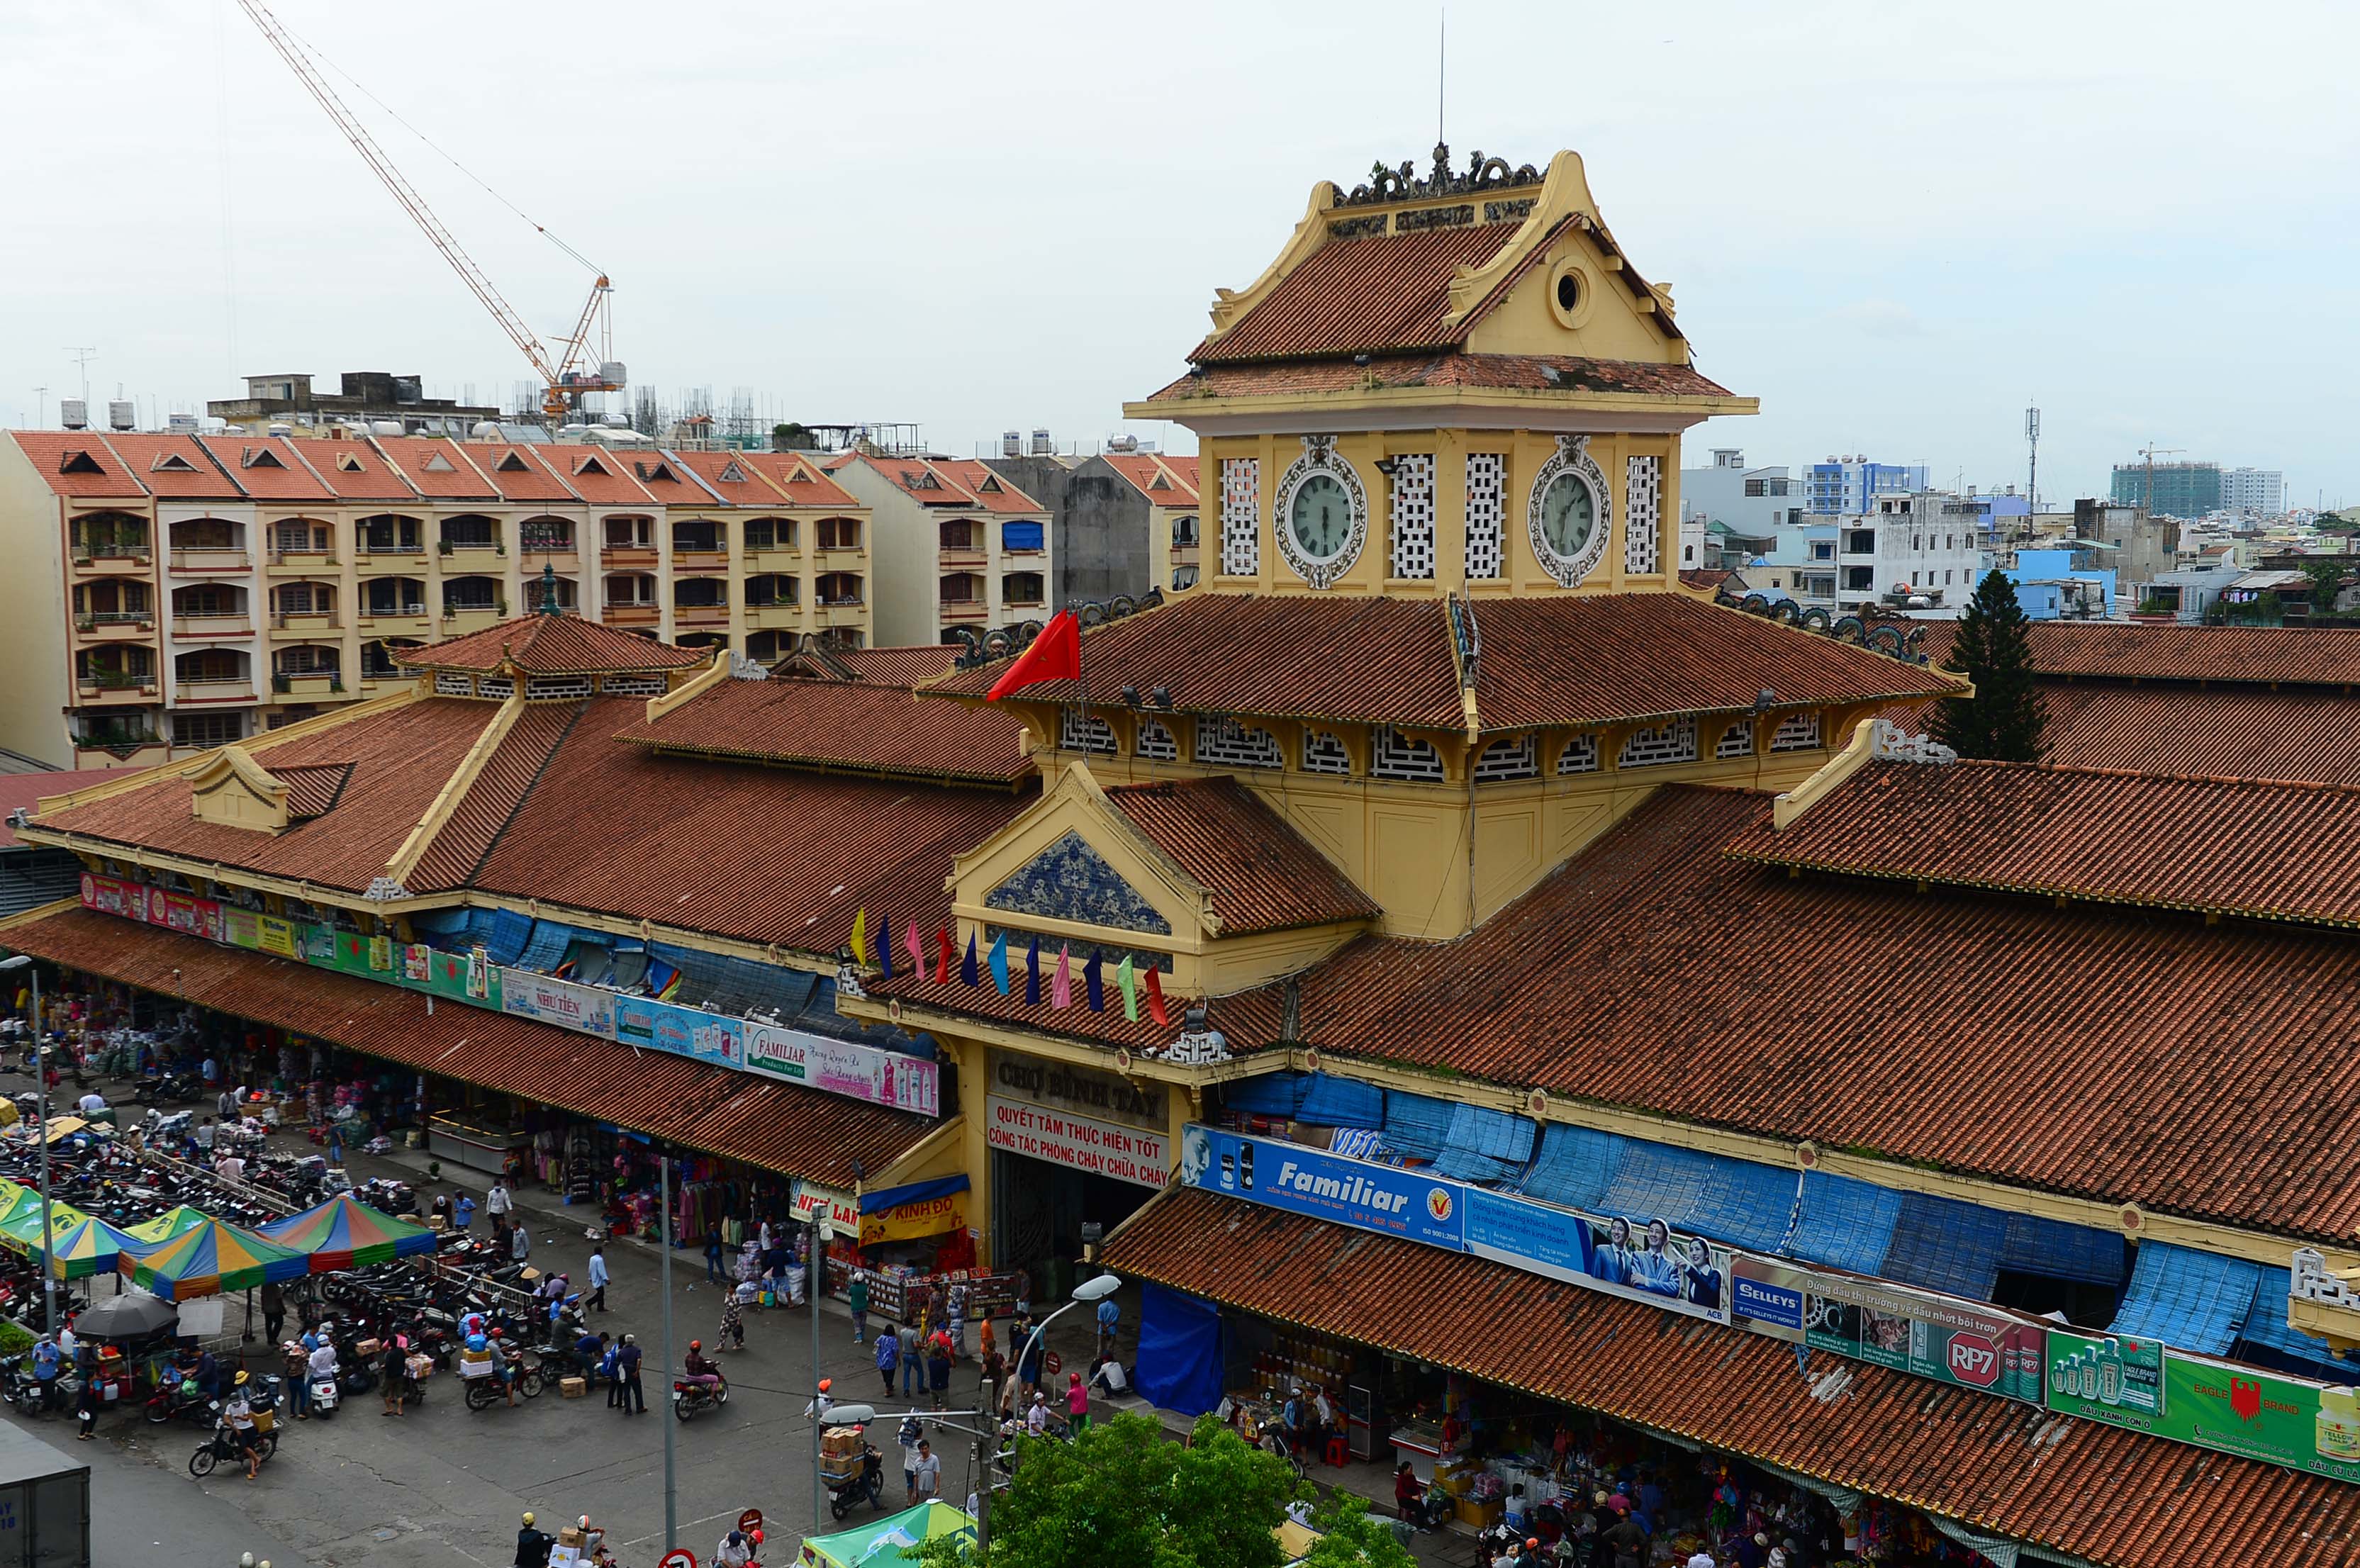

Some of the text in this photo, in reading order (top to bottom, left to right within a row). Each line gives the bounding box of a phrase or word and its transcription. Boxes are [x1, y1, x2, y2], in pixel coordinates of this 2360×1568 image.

[759, 1039, 805, 1063] FAMILIAR
[762, 1058, 783, 1070] Products
[794, 1066, 803, 1076] Life
[997, 1105, 1160, 1159] QUYẾT TÂM THỰC HIỆN TỐT
[989, 1126, 1168, 1187] CÔNG TÁC PHÒNG CHÁY CHỮA CHÁY
[1277, 1161, 1409, 1214] Familiar
[895, 1203, 931, 1220] KINH
[1509, 1213, 1526, 1225] cùng
[1548, 1223, 1565, 1236] hàng
[1548, 1235, 1569, 1247] doanh
[1740, 1284, 1796, 1309] SELLEYS
[1706, 1310, 1723, 1320] ACB
[1807, 1279, 1997, 1333] Đứng đầu thị trường về dầu nhớt bôi trơn
[1753, 1309, 1772, 1318] SELLEYS
[1777, 1316, 1796, 1325] WORKS
[1952, 1343, 1993, 1374] RP7
[2006, 1358, 2018, 1367] RP7
[2022, 1358, 2037, 1370] RP7
[2140, 1368, 2157, 1378] BRAND
[2193, 1384, 2300, 1416] EAGLE BRAND
[2101, 1411, 2123, 1422] XANH
[2125, 1417, 2141, 1427] CON
[2324, 1430, 2353, 1441] YELLOW
